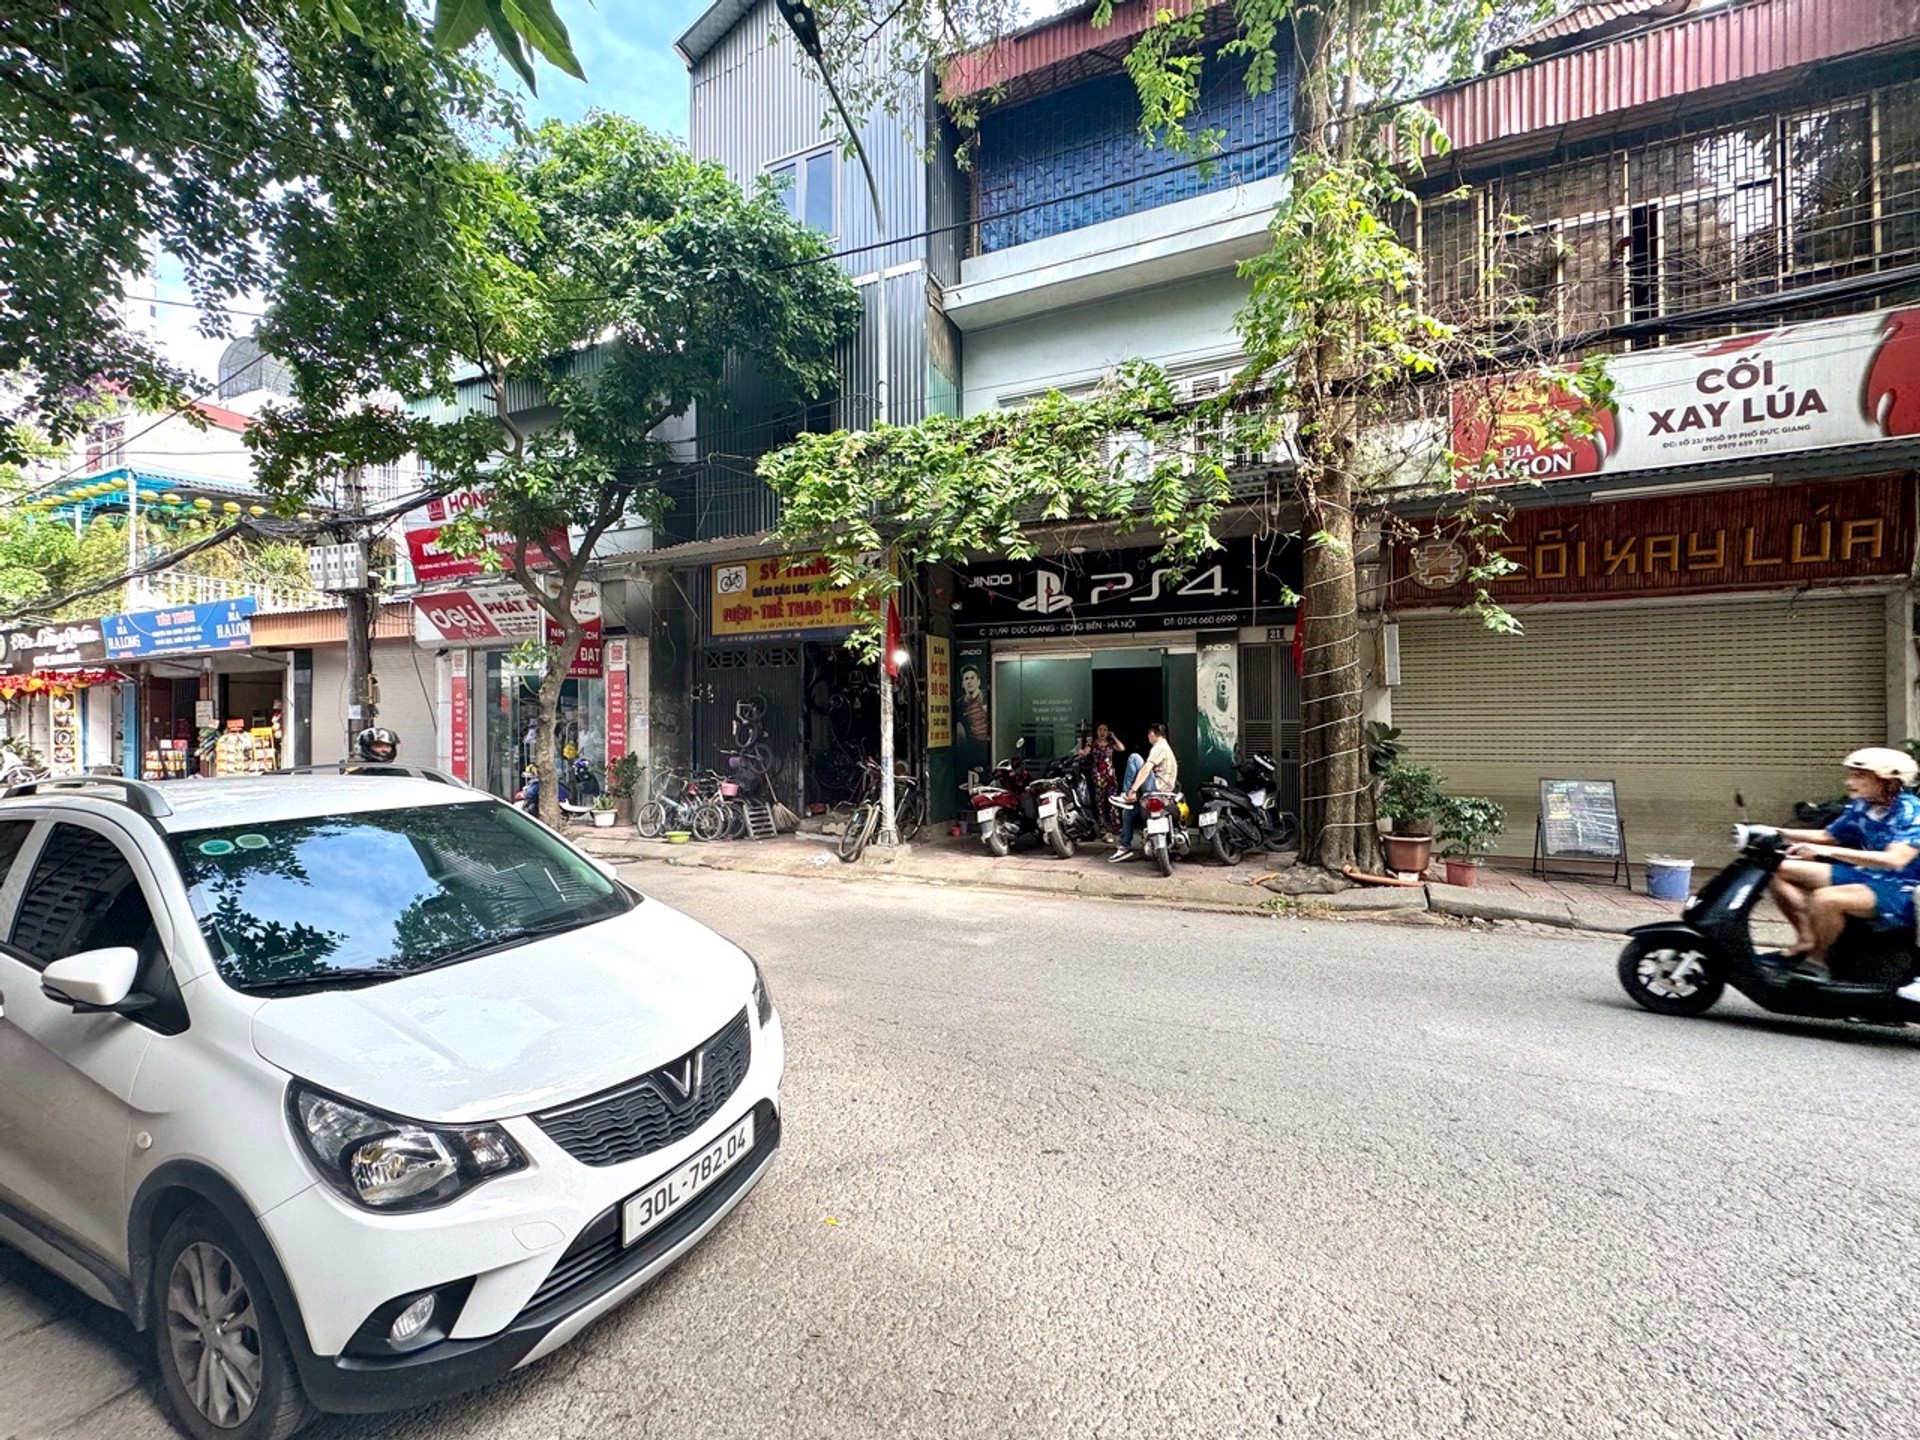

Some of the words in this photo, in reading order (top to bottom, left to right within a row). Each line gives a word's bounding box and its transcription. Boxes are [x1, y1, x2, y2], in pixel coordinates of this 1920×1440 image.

[1696, 352, 1773, 394] CỐI
[1648, 400, 1730, 436] XAY
[1742, 385, 1828, 423] LÚA
[1781, 423, 1812, 433] GIANG
[1603, 534, 1726, 576] XAY
[1744, 504, 1884, 567] LÚA
[968, 574, 1013, 588] JINDO
[1090, 564, 1229, 605] PS4
[429, 604, 486, 629] deli
[760, 597, 785, 619] THỂ
[787, 599, 823, 618] THAO
[1215, 614, 1238, 623] 6999
[1029, 624, 1056, 634] GIANG
[1061, 622, 1084, 632] LONG
[1203, 643, 1232, 651] JINDO
[639, 1126, 746, 1227] 30L-782.04
